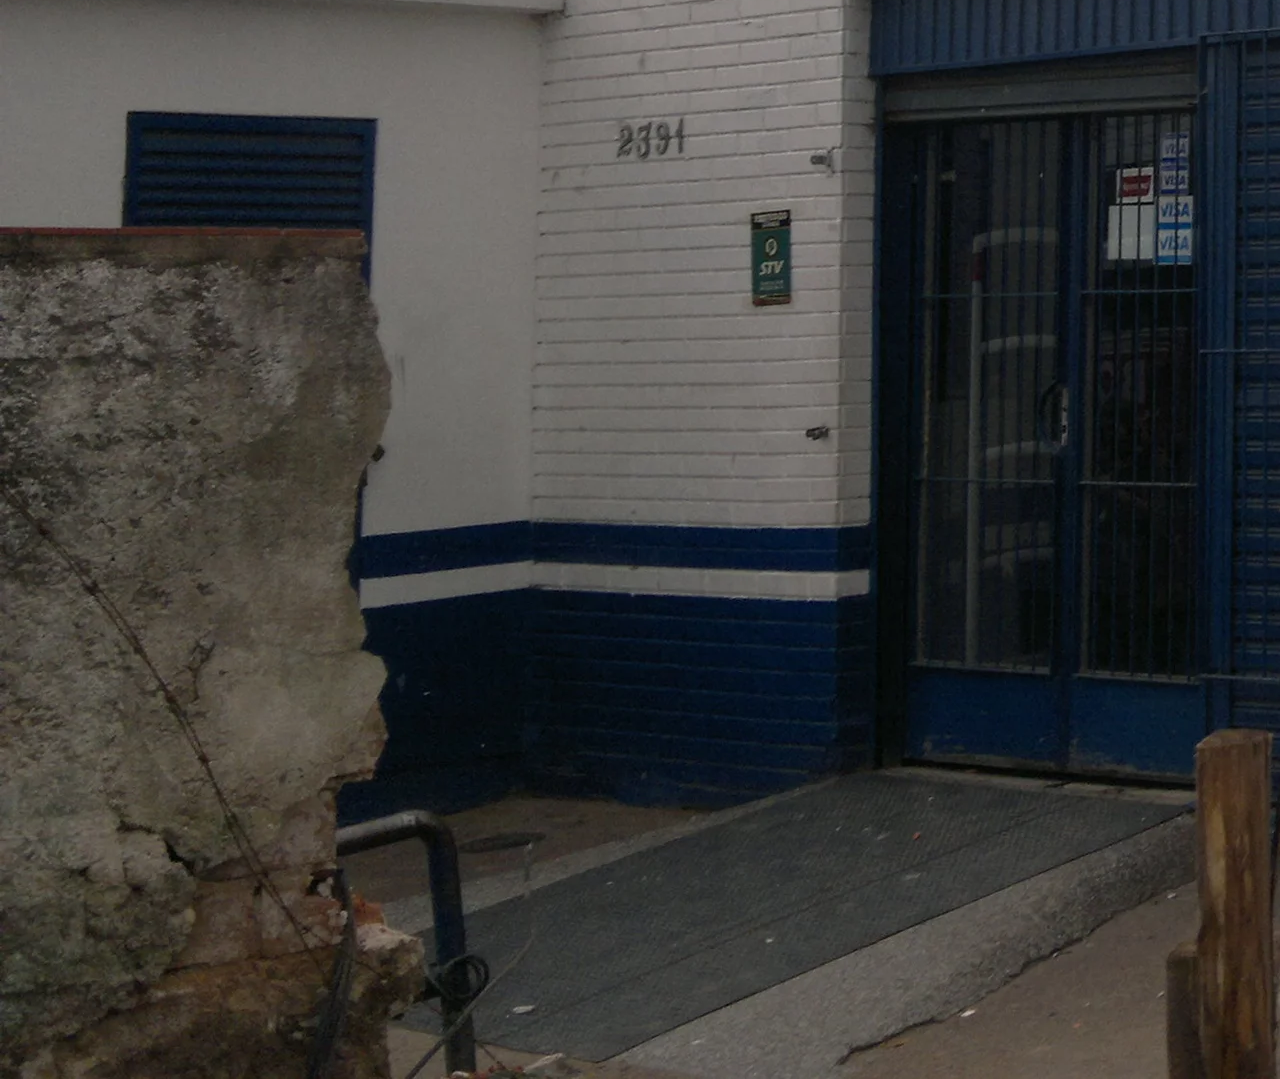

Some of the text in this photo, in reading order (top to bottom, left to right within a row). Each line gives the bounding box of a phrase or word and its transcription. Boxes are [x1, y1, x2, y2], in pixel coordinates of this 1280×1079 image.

[616, 117, 684, 160] 2391
[1161, 203, 1190, 218] VISA
[1160, 236, 1190, 251] VISA
[759, 259, 785, 276] STV
